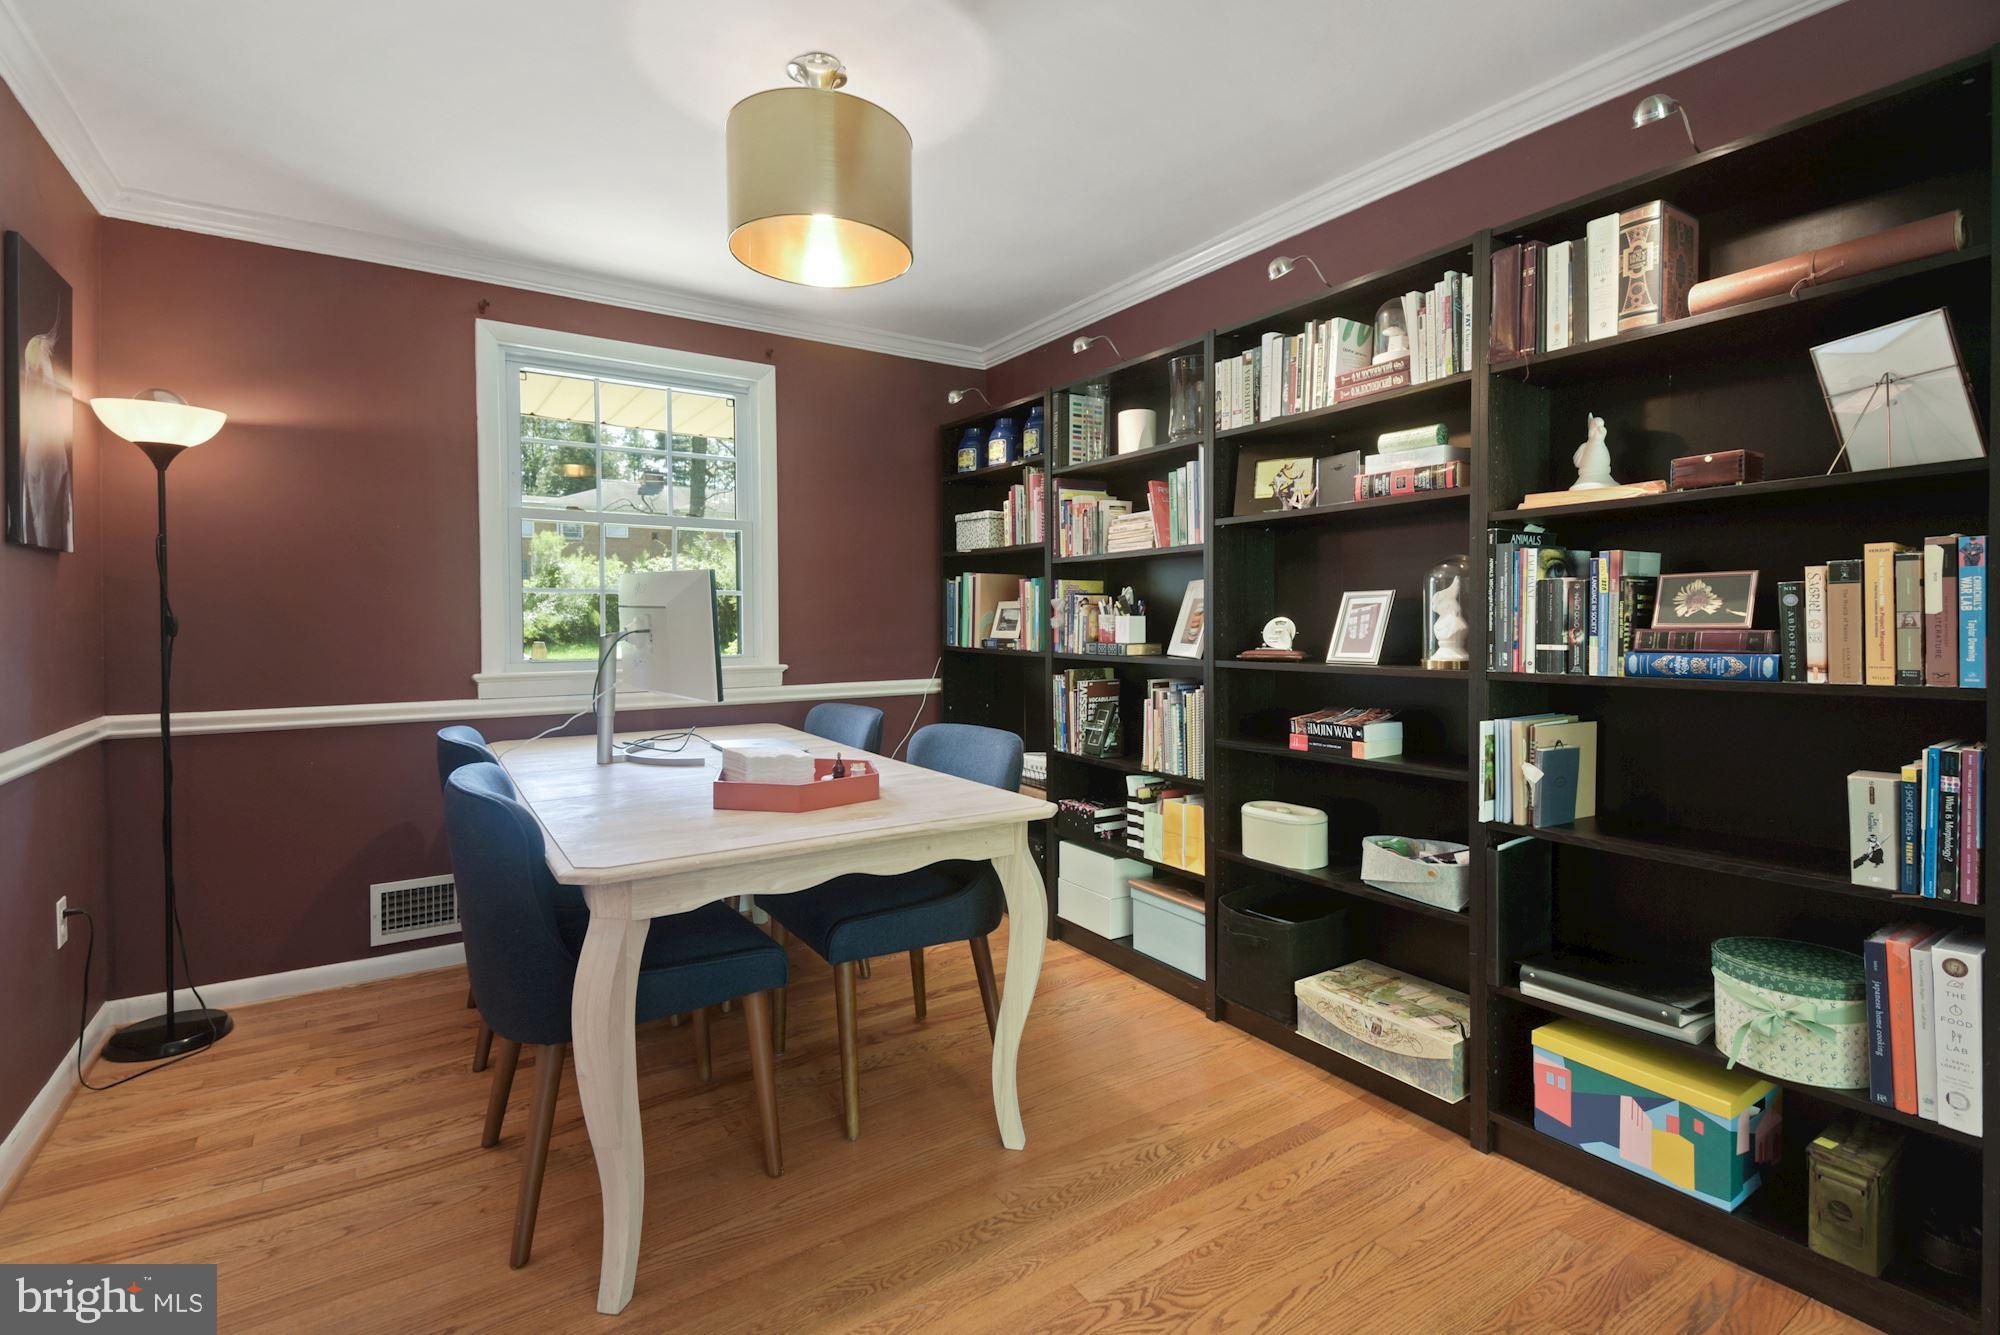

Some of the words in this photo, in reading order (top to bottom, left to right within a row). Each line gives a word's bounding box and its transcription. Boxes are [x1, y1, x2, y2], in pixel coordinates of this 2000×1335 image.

[1510, 534, 1541, 546] ANIMALS
[1960, 576, 1973, 595] WAR
[1973, 575, 1983, 611] CHURCHILL'S
[1960, 596, 1973, 611] LAB
[1966, 619, 1977, 637] Taylor
[1966, 638, 1978, 662] Downing
[1334, 725, 1354, 738] WAR
[1904, 788, 1914, 811] SHORT
[1946, 795, 1954, 812] What
[1904, 812, 1914, 836] STORIES
[1942, 820, 1953, 862] Morphology?
[1871, 980, 1882, 1009] japanese
[1945, 990, 1967, 1001] THE
[1875, 1010, 1883, 1028] home
[1940, 1016, 1973, 1029] FOOD
[1875, 1029, 1885, 1057] cooking
[1946, 1044, 1968, 1055] LAB
